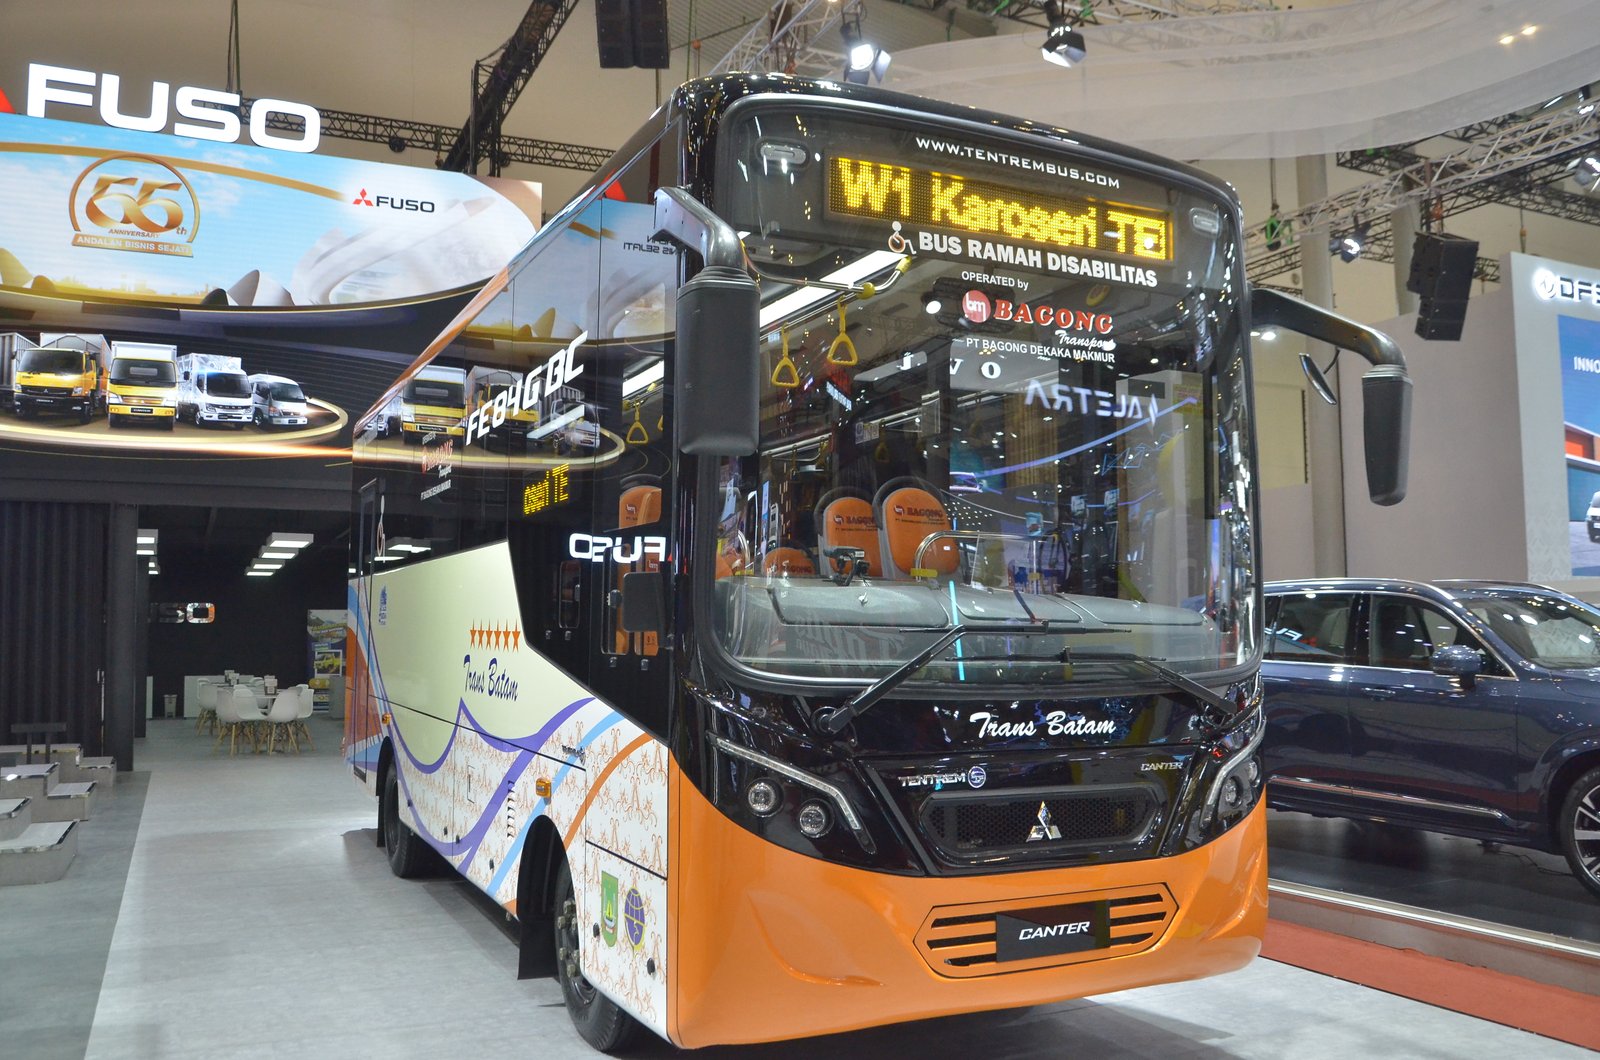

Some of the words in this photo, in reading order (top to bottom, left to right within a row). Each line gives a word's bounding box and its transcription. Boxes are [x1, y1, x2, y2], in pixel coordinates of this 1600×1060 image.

[27, 63, 321, 153] FUSO
[915, 136, 1121, 189] WWW.TENTREMBUS.COM
[376, 195, 435, 213] FUSO
[838, 158, 911, 217] W1
[931, 176, 1097, 248] Karoseri
[77, 236, 122, 248] ANDALAN
[125, 240, 155, 251] BISNIS
[108, 228, 160, 239] ANNIVERSARY
[918, 231, 962, 256] BUS
[967, 238, 1042, 269] RAMAH
[1047, 252, 1158, 288] DISABILITAS
[961, 270, 1015, 288] OPERATED
[1017, 279, 1029, 292] by
[993, 299, 1113, 335] BAGONG
[544, 330, 588, 398] BC
[966, 337, 980, 348] PT
[982, 339, 1028, 354] BAGONG
[1030, 345, 1070, 359] DEKAKA
[1072, 350, 1116, 364] MAKMUR
[463, 654, 485, 694] Trans
[488, 657, 519, 702] Batam
[969, 711, 1037, 739] Trans
[1045, 710, 1117, 736] Batam
[898, 772, 966, 787] TENTREM
[1140, 761, 1184, 772] CANTER
[1018, 921, 1091, 941] CANTER
